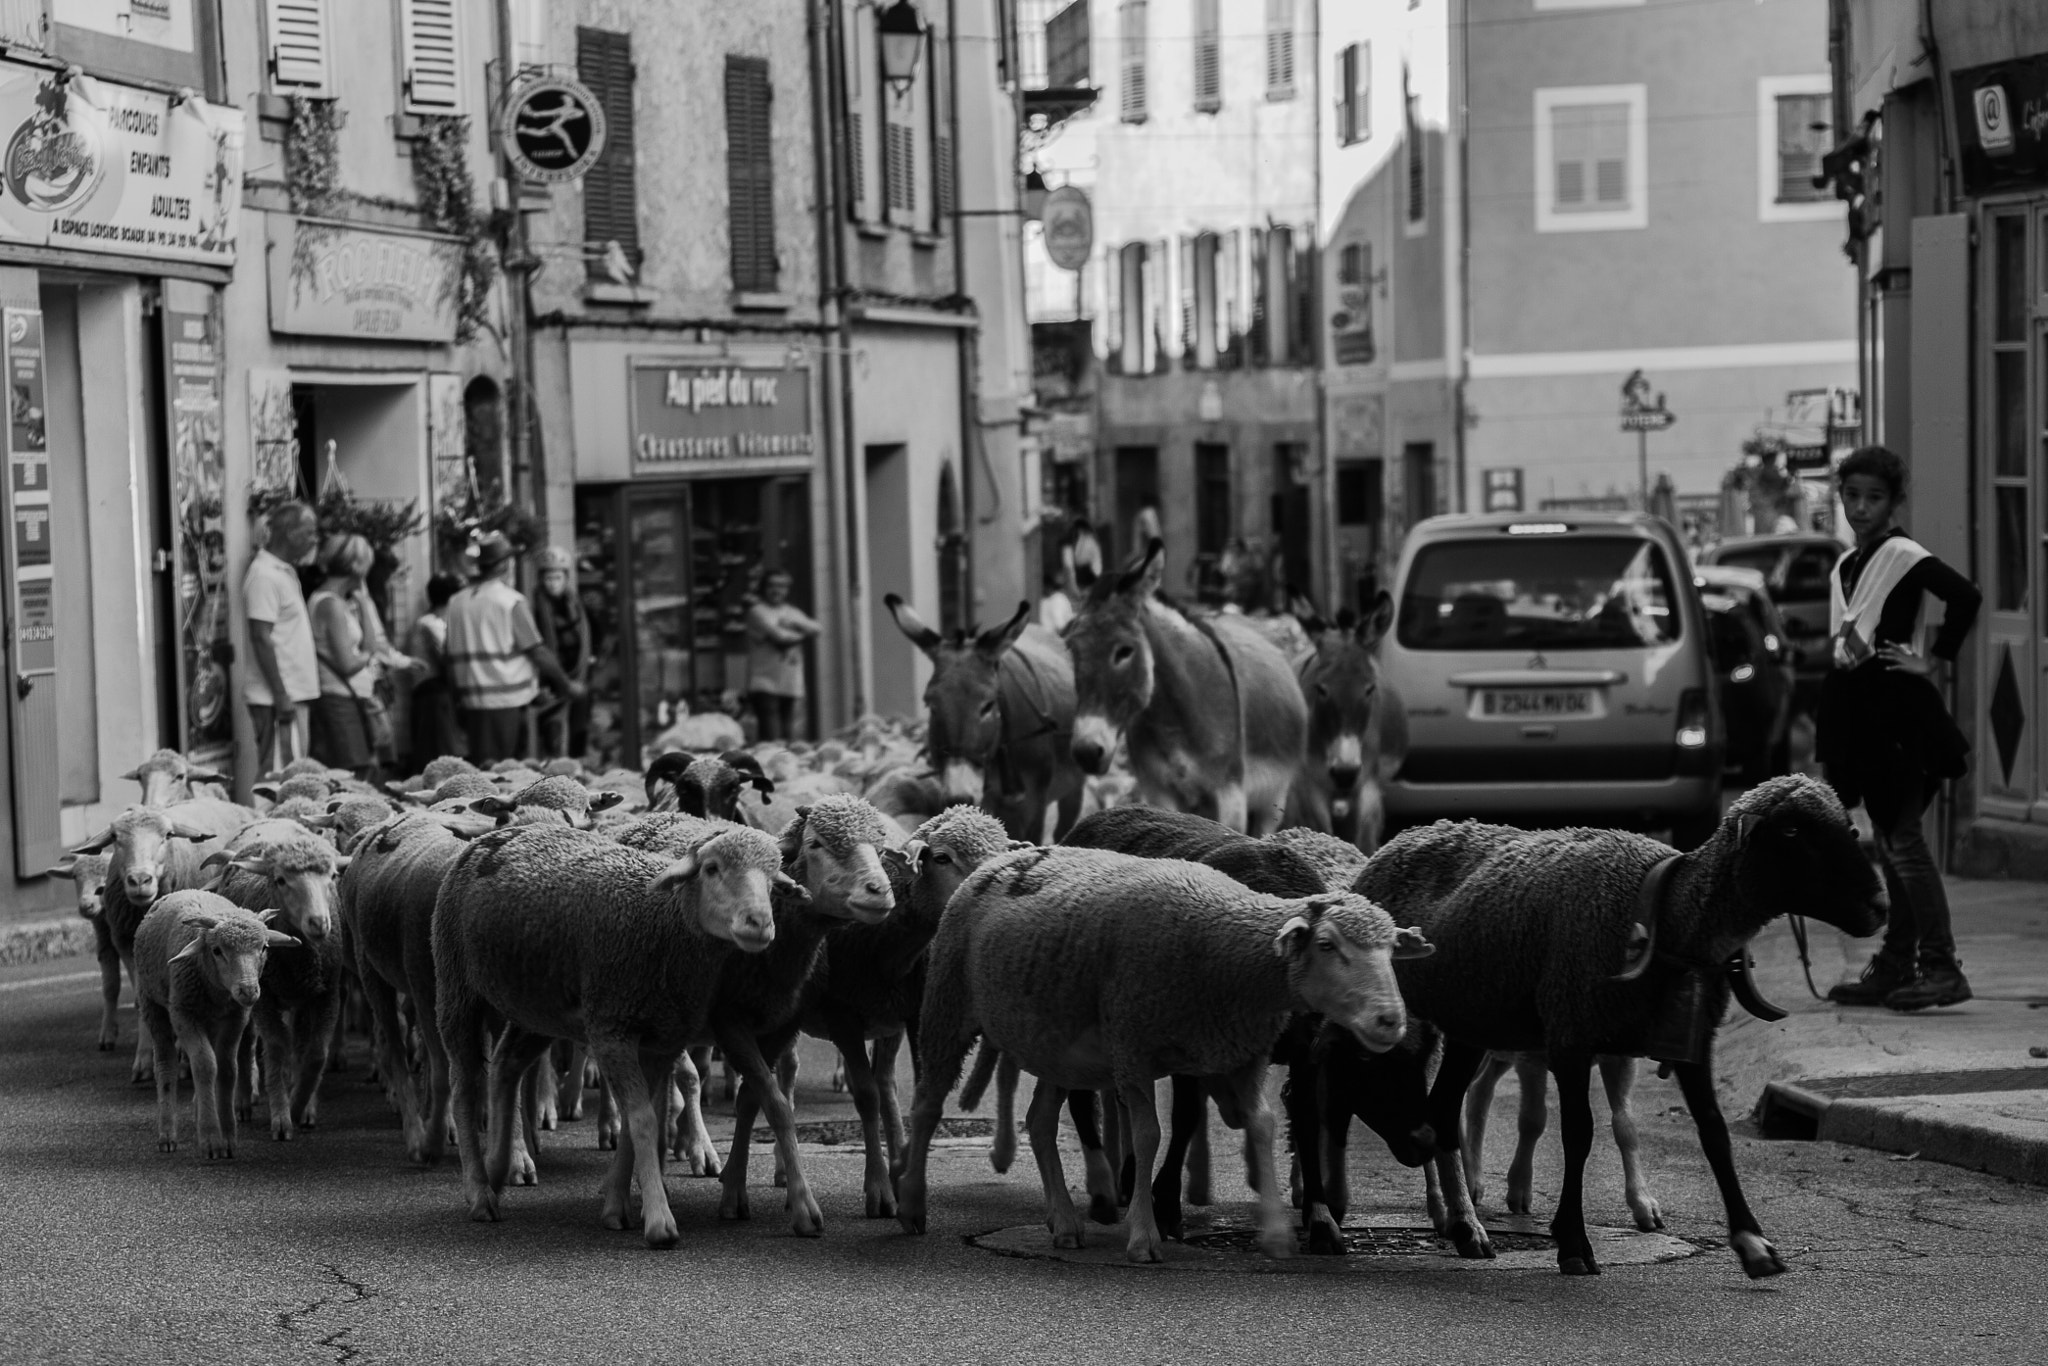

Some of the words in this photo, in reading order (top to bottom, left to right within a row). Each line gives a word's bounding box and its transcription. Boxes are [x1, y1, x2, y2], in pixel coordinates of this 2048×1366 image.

[108, 105, 160, 137] PARCOURS
[130, 150, 171, 178] ENFANTS
[150, 194, 191, 221] ADULTES
[52, 218, 59, 234] A
[61, 218, 89, 238] ESPACE
[90, 222, 119, 240] LOISIRS
[667, 369, 690, 406] Au
[692, 368, 728, 413] pied
[729, 368, 750, 406] du
[752, 377, 778, 406] roc
[637, 433, 730, 460] Chaussures
[736, 431, 814, 457] Vêtements
